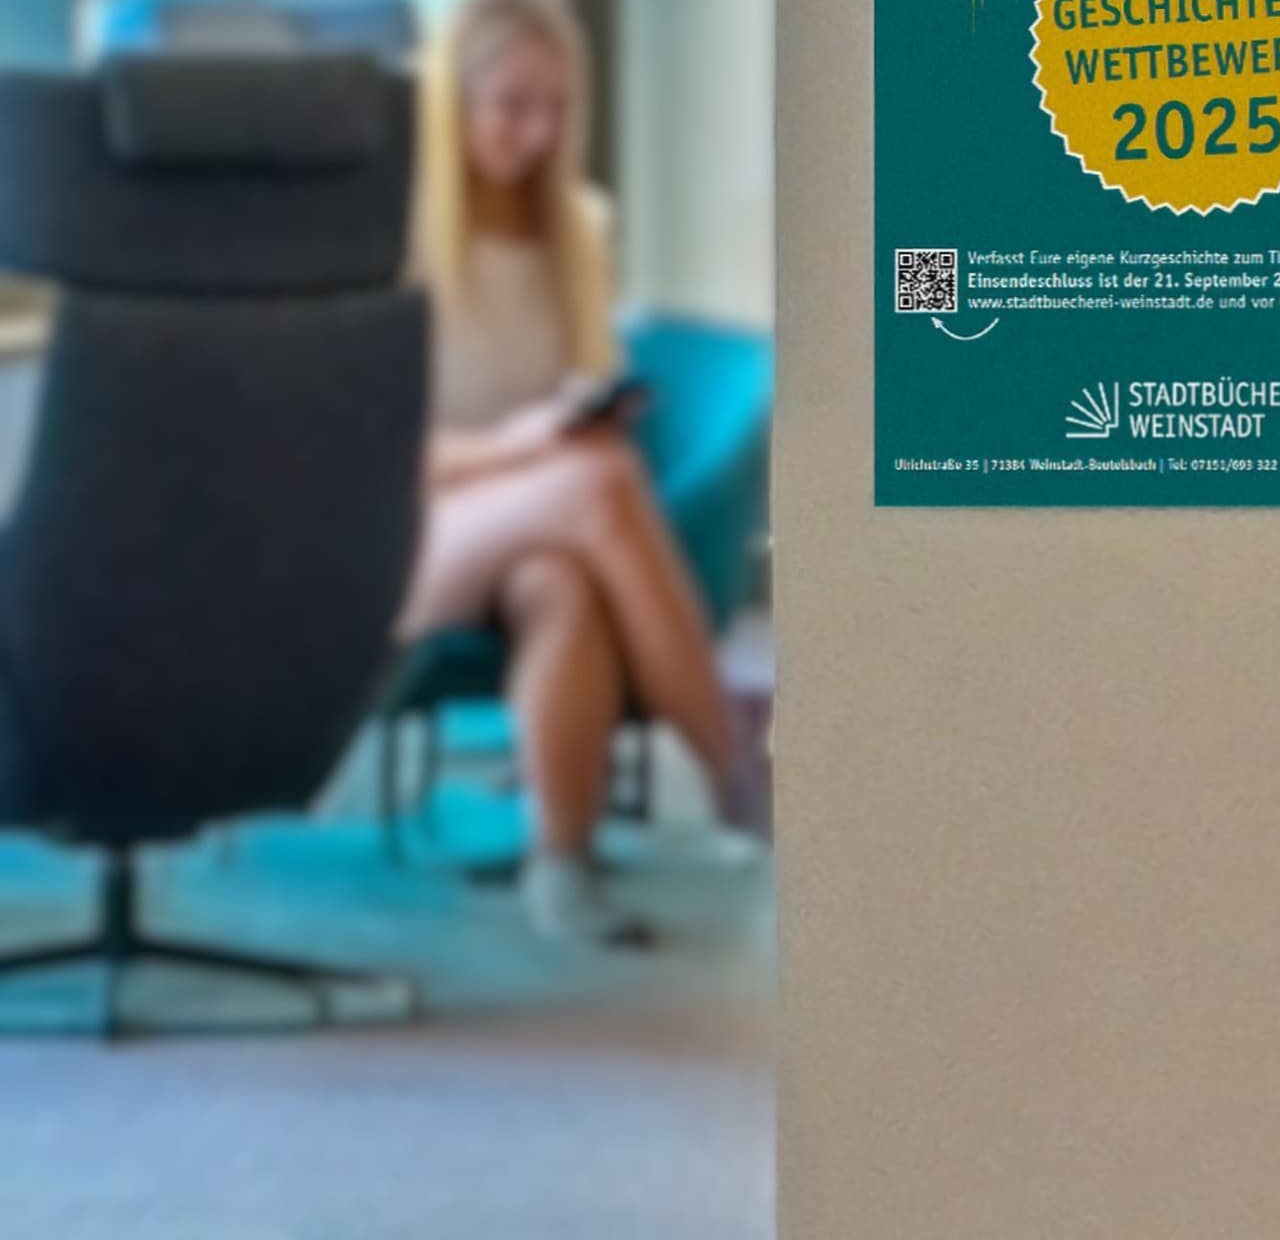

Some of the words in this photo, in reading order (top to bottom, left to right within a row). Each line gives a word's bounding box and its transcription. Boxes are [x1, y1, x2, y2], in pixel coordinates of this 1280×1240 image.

[967, 250, 1025, 265] Verfasst
[1030, 249, 1062, 265] Eure
[1066, 250, 1115, 269] eigene
[1120, 249, 1229, 268] Kurzgeschichte
[1233, 253, 1264, 265] zum
[967, 272, 1093, 289] Einsendeschluss
[1098, 272, 1119, 289] ist
[1123, 272, 1149, 288] der
[1154, 271, 1180, 288] 21.
[1184, 271, 1269, 292] September
[967, 294, 1214, 309] www.stadtbuecherei-weinstadt.de
[1219, 294, 1246, 309] und
[1251, 297, 1275, 309] vor
[1129, 413, 1266, 439] WEINSTADT
[965, 459, 980, 471] 35
[1257, 459, 1278, 471] 322
